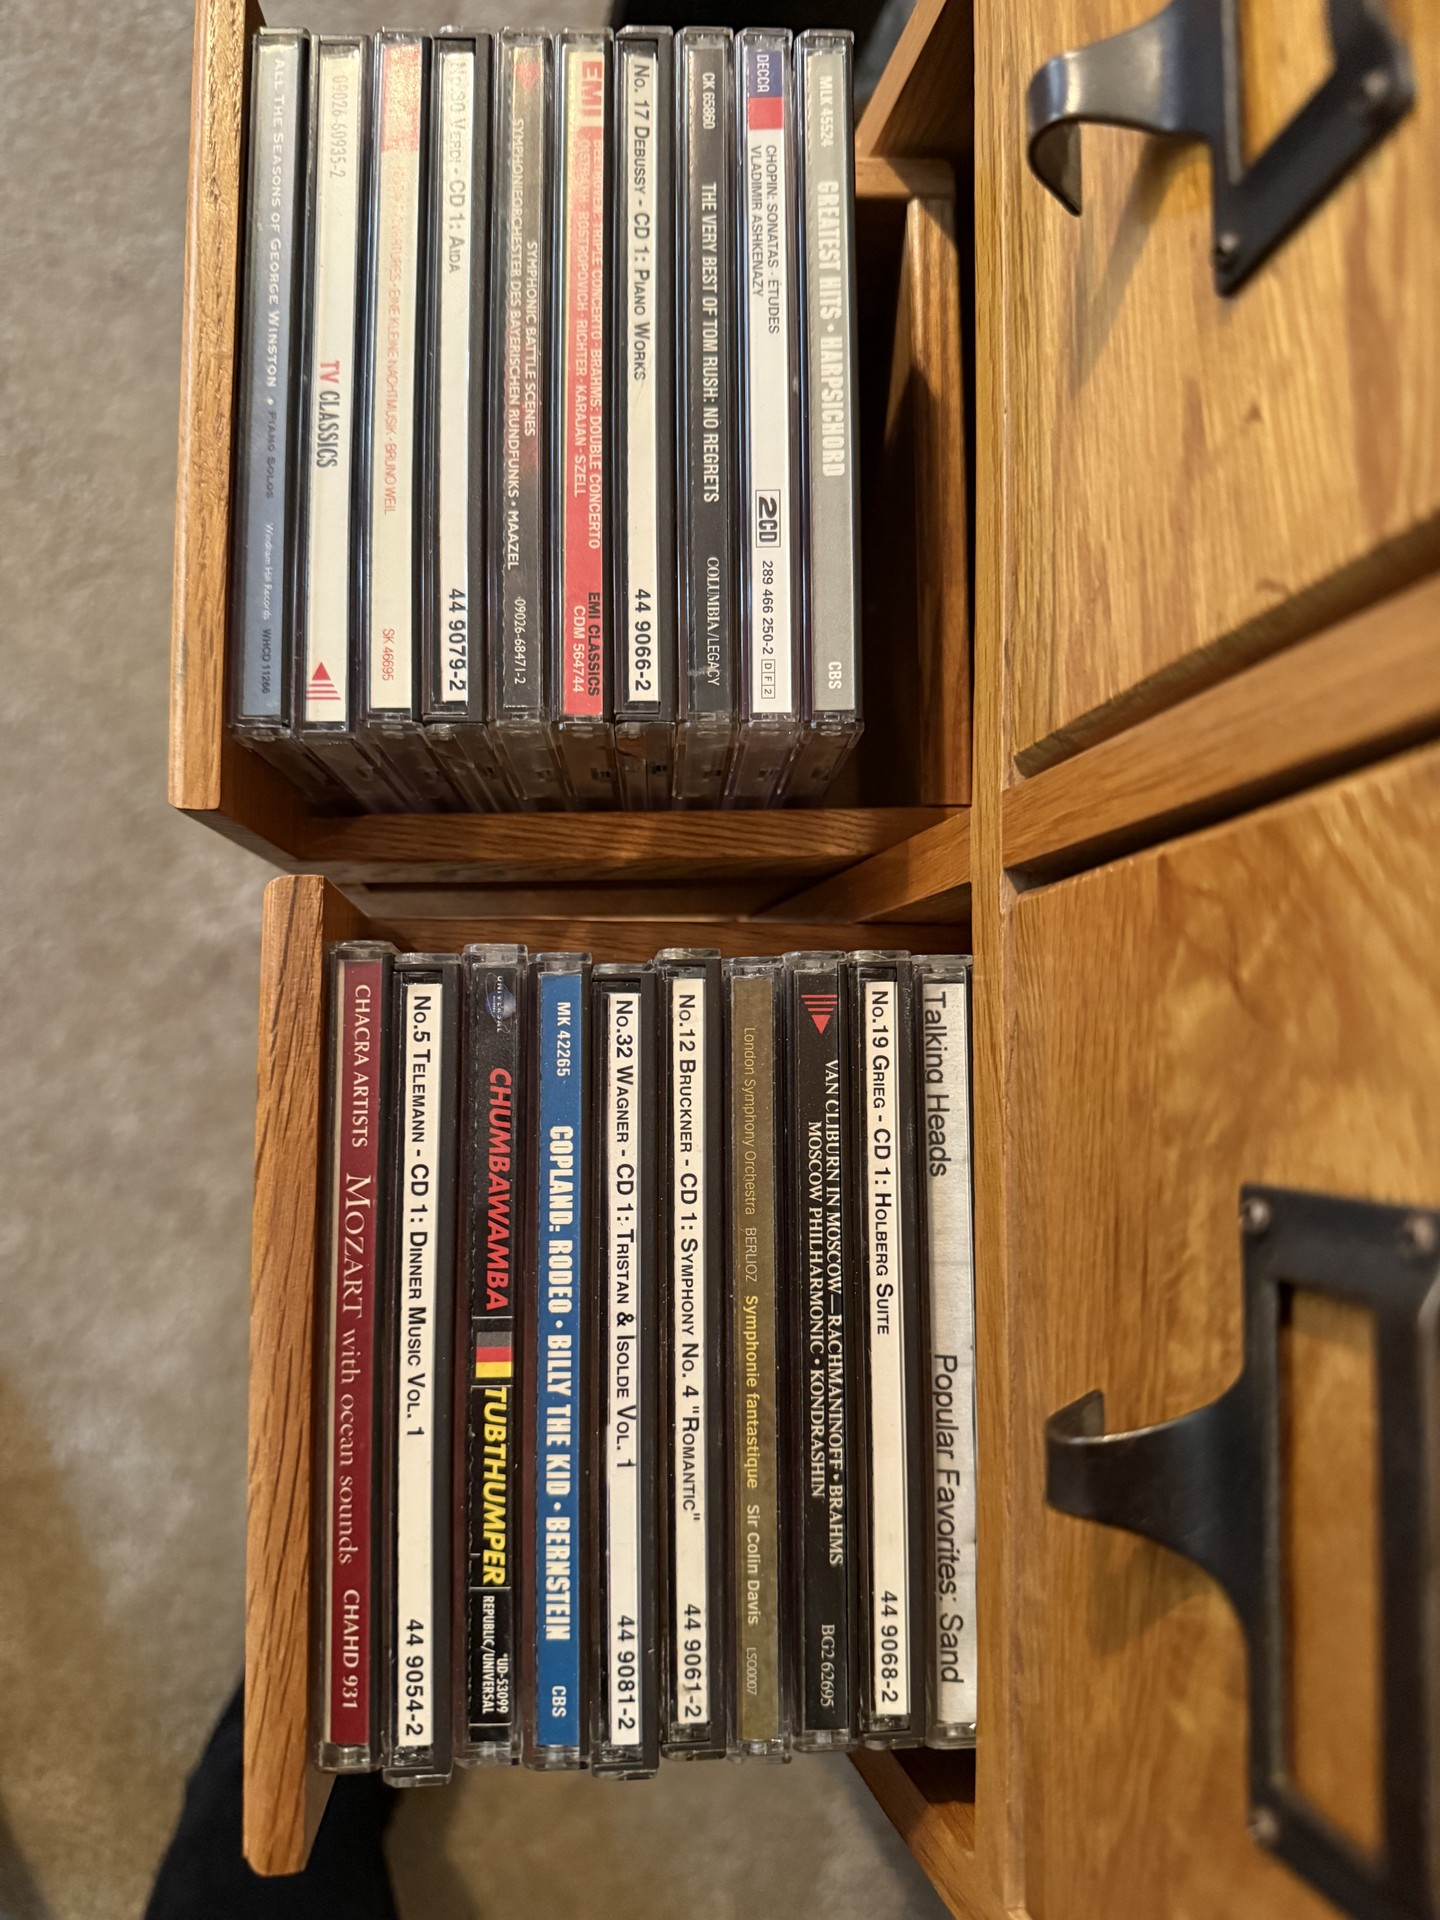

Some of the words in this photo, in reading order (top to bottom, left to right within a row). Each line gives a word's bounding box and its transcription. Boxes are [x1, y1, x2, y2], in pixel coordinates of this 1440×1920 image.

[582, 60, 602, 117] EMI
[702, 72, 715, 90] CK
[756, 54, 769, 93] DECCA
[819, 76, 832, 105] MLK
[634, 100, 650, 120] 17
[703, 92, 715, 129] 65860
[820, 107, 834, 147] 45524
[449, 180, 466, 207] CD
[750, 145, 762, 212] VLADIMIR
[765, 145, 777, 200] CHOPIN:
[701, 183, 716, 212] THE
[592, 222, 602, 266] TRIPLE
[634, 212, 650, 239] CD
[702, 214, 717, 252] VERY
[766, 203, 778, 268] SONATAS
[818, 181, 840, 270] GREATEST
[576, 211, 589, 311] ROSTROPOVICH
[702, 256, 717, 292] BEST
[752, 214, 764, 297] ASHKENAZY
[510, 282, 522, 306] DES
[526, 241, 538, 323] SYMPHONIC
[590, 270, 602, 340] CONCERTO
[819, 277, 841, 319] HITS
[702, 297, 718, 316] OF
[508, 311, 521, 404] BAYERISCHEN
[524, 327, 536, 378] BATTLE
[576, 320, 588, 376] RICHTER
[702, 320, 718, 351] TOM
[320, 360, 340, 384] TV
[590, 350, 602, 411] BRAHMS:
[703, 356, 718, 402] RUSH:
[386, 360, 398, 435] NACHTMUSIK
[524, 382, 536, 436] SCENES
[574, 385, 587, 446] KARAJAN
[703, 408, 718, 429] NO
[820, 336, 844, 476] HARPSICHORD
[316, 391, 339, 468] CLASSICS
[508, 409, 520, 498] RUNDFUNKS
[590, 416, 602, 470] DOUBLE
[385, 444, 396, 485] BRUNO
[574, 455, 586, 497] SZELL
[704, 433, 720, 502] REGRETS
[384, 488, 396, 515] WEIL
[588, 474, 601, 548] CONCERTO
[758, 496, 778, 543] 2CD
[508, 510, 520, 570] MAAZEL
[762, 560, 773, 585] 289
[262, 584, 273, 620] Records
[449, 588, 466, 613] 44
[573, 606, 585, 639] CDM
[588, 592, 600, 619] EMI
[636, 588, 650, 613] 44
[706, 557, 720, 686] COLUMBIA/LEGACY
[762, 589, 774, 614] 466
[262, 628, 272, 662] WHCD
[383, 628, 394, 644] SK
[449, 620, 466, 692] 9079-2
[514, 598, 526, 684] 09026-68471-2
[588, 624, 600, 696] CLASSICS
[636, 620, 651, 692] 9066-2
[762, 618, 774, 654] 250-2
[261, 665, 271, 694] 11266
[382, 647, 394, 680] 46695
[572, 644, 585, 692] 564744
[828, 661, 842, 690] CBS
[354, 984, 370, 1066] CHACRA
[556, 1002, 570, 1026] MK
[924, 991, 948, 1084] Talking
[556, 1030, 570, 1076] 42265
[744, 1028, 757, 1075] London
[824, 1060, 838, 1095] VAN
[352, 1071, 370, 1148] ARTISTS
[740, 1080, 757, 1146] Symphony
[826, 1100, 840, 1183] CLIBURN
[873, 1128, 891, 1160] CD
[926, 1094, 952, 1177] Heads
[410, 1164, 429, 1196] CD
[548, 1126, 574, 1232] COPLAND:
[616, 1164, 634, 1195] CD
[744, 1150, 758, 1214] Orchestra
[808, 1122, 822, 1202] MOSCOW
[486, 1068, 512, 1311] CHUMBAWAMBA
[680, 1173, 698, 1204] CD
[826, 1187, 840, 1206] IN
[342, 1173, 372, 1318] MOZART
[745, 1228, 757, 1282] BERLIOZ
[548, 1240, 572, 1314] RODEO
[809, 1208, 824, 1354] PHILHARMONIC
[616, 1312, 635, 1327] &
[744, 1296, 759, 1387] Symphonie
[340, 1329, 361, 1384] with
[546, 1335, 572, 1396] BILLY
[682, 1386, 699, 1398] 4
[933, 1354, 958, 1459] Popular
[340, 1394, 355, 1465] ocean
[408, 1427, 424, 1436] 1
[546, 1405, 571, 1446] THE
[744, 1392, 760, 1489] fantastique
[810, 1369, 824, 1497] KONDRASHIN
[482, 1388, 508, 1586] TUBTHUMPER
[546, 1454, 570, 1495] KID
[617, 1459, 636, 1468] 1
[338, 1476, 359, 1564] sounds
[747, 1504, 760, 1528] Sir
[828, 1485, 844, 1565] BRAHMS
[936, 1468, 962, 1601] Favorites:
[747, 1532, 760, 1574] Colin
[545, 1516, 570, 1640] BERNSTEIN
[684, 1604, 700, 1630] 44
[747, 1580, 760, 1625] Davis
[880, 1590, 898, 1617] 44
[342, 1590, 359, 1667] CHAHD
[406, 1620, 424, 1646] 44
[618, 1615, 634, 1642] 44
[821, 1624, 835, 1659] BG2
[940, 1612, 964, 1683] Sand
[481, 1596, 495, 1714] REPUBLIC/UNIVERSAL
[684, 1640, 701, 1718] 9061-2
[746, 1647, 757, 1696] LSO0007
[881, 1624, 898, 1702] 9068-2
[341, 1675, 358, 1709] 931
[406, 1656, 424, 1736] 9054-2
[552, 1685, 566, 1717] CBS
[618, 1651, 634, 1730] 9081-2
[820, 1662, 835, 1706] 62695
